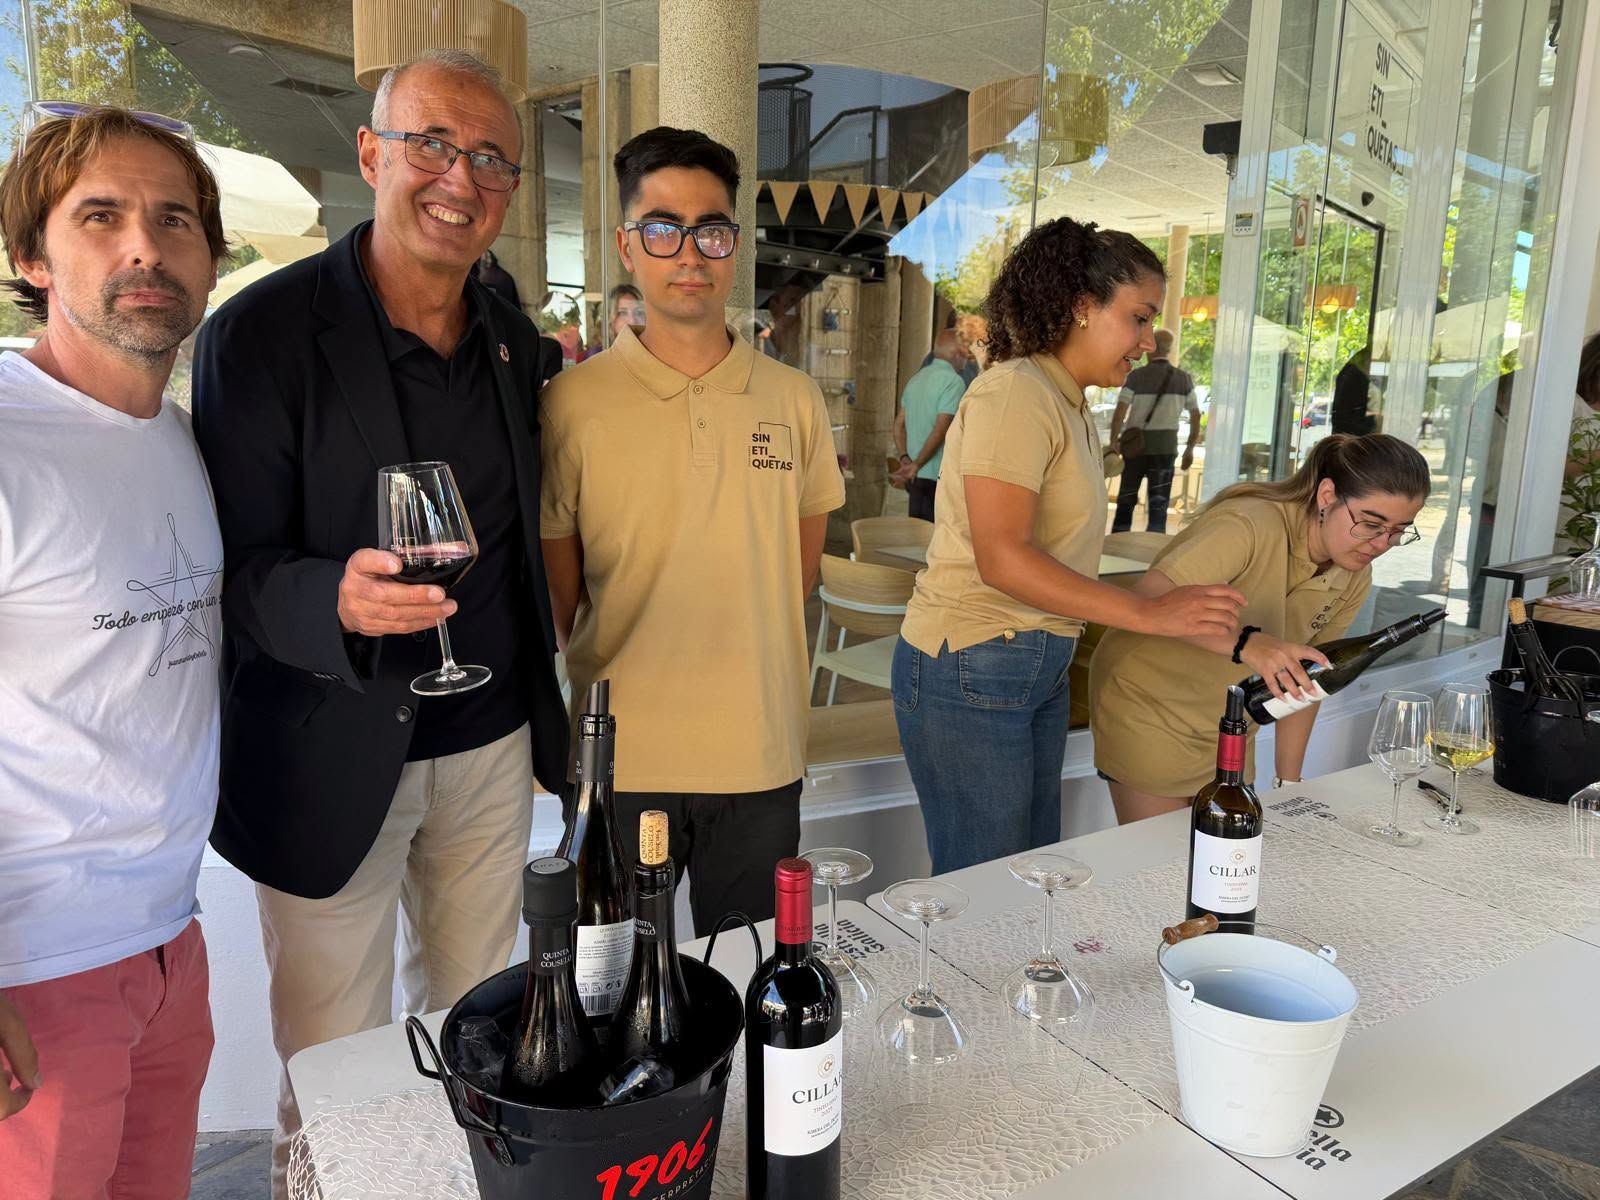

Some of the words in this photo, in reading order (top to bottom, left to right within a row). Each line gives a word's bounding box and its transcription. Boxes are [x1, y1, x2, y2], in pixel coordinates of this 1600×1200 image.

[1376, 42, 1391, 80] SIN
[1367, 126, 1397, 172] QUETAS
[752, 433, 770, 443] SIN
[752, 459, 793, 471] QUETAS
[92, 610, 139, 630] Todo
[141, 600, 185, 626] empezó
[187, 598, 205, 612] con
[205, 596, 217, 607] un
[1209, 865, 1257, 878] CILLAR
[837, 919, 885, 954] Galicia
[540, 954, 572, 968] COUSELO
[542, 948, 570, 961] QUINTA
[596, 1117, 713, 1200] 1906
